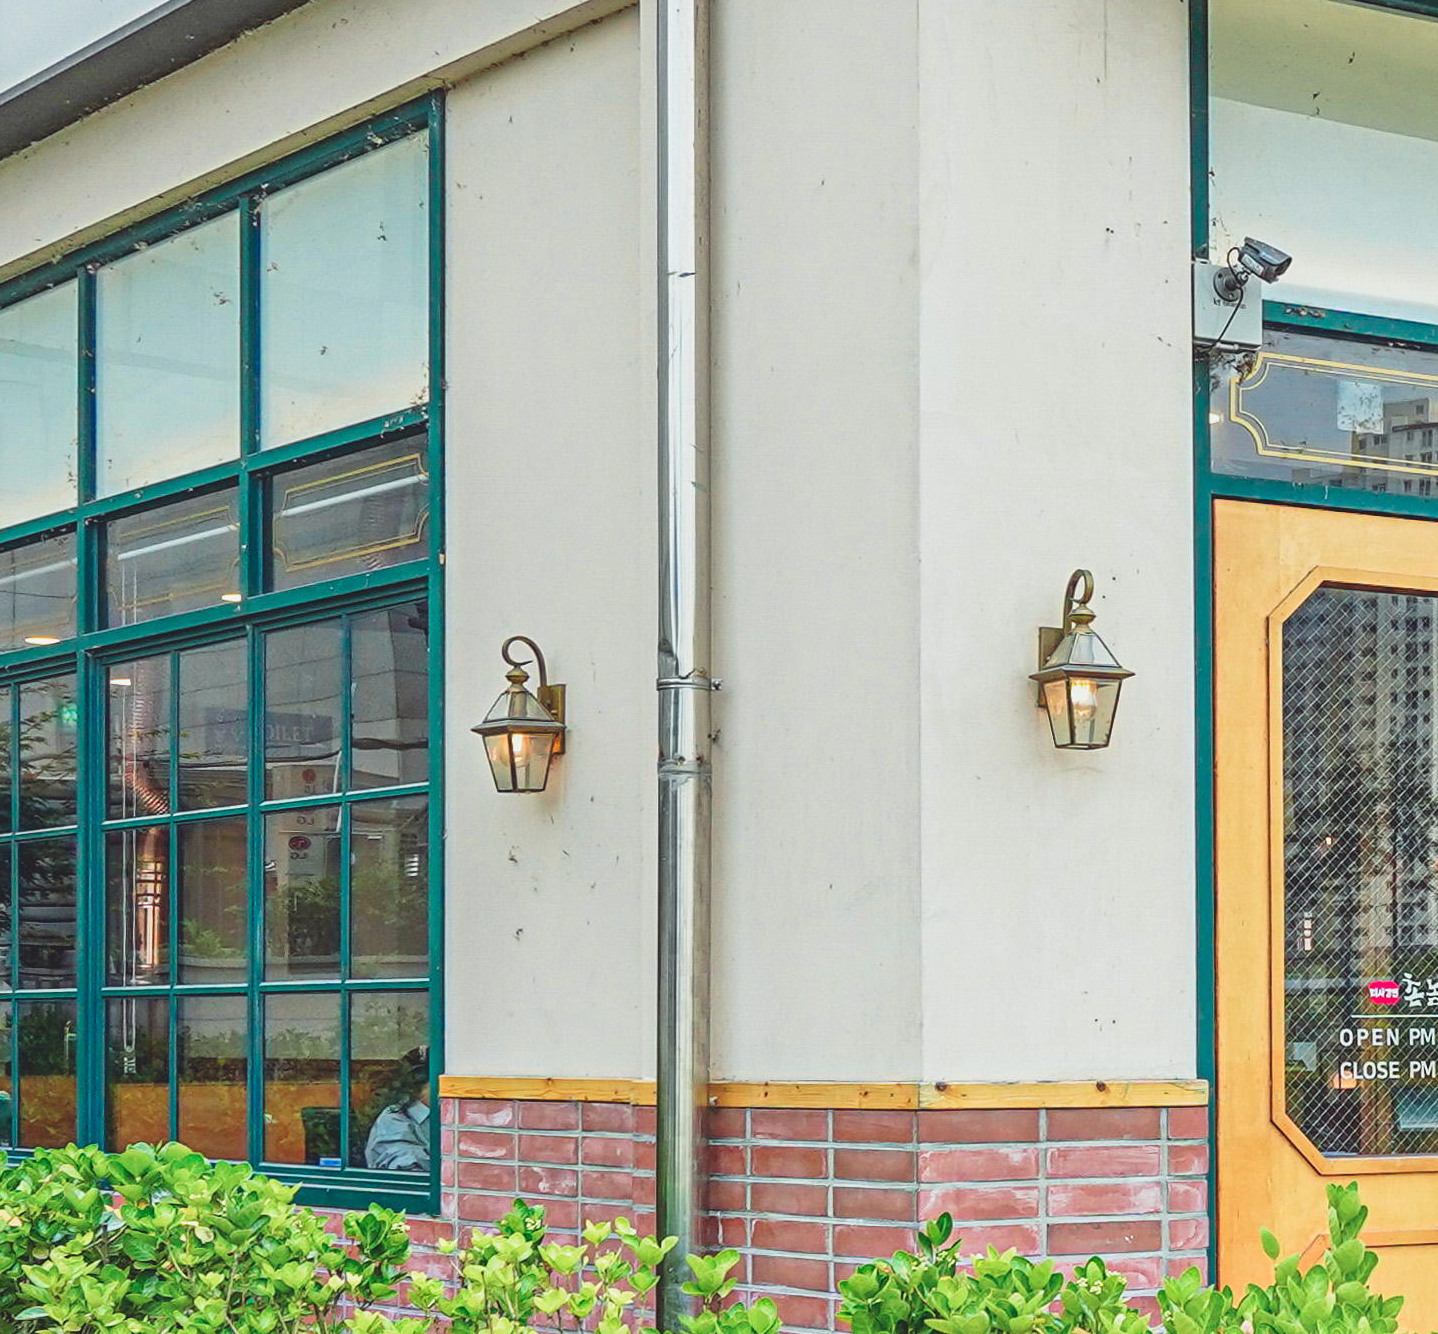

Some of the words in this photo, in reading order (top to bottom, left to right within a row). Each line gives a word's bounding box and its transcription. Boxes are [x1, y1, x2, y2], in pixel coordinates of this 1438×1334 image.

[1339, 1028, 1400, 1047] OPEN
[1409, 1028, 1436, 1046] PM
[1340, 1061, 1401, 1080] CLOSE
[1409, 1061, 1437, 1079] PM
